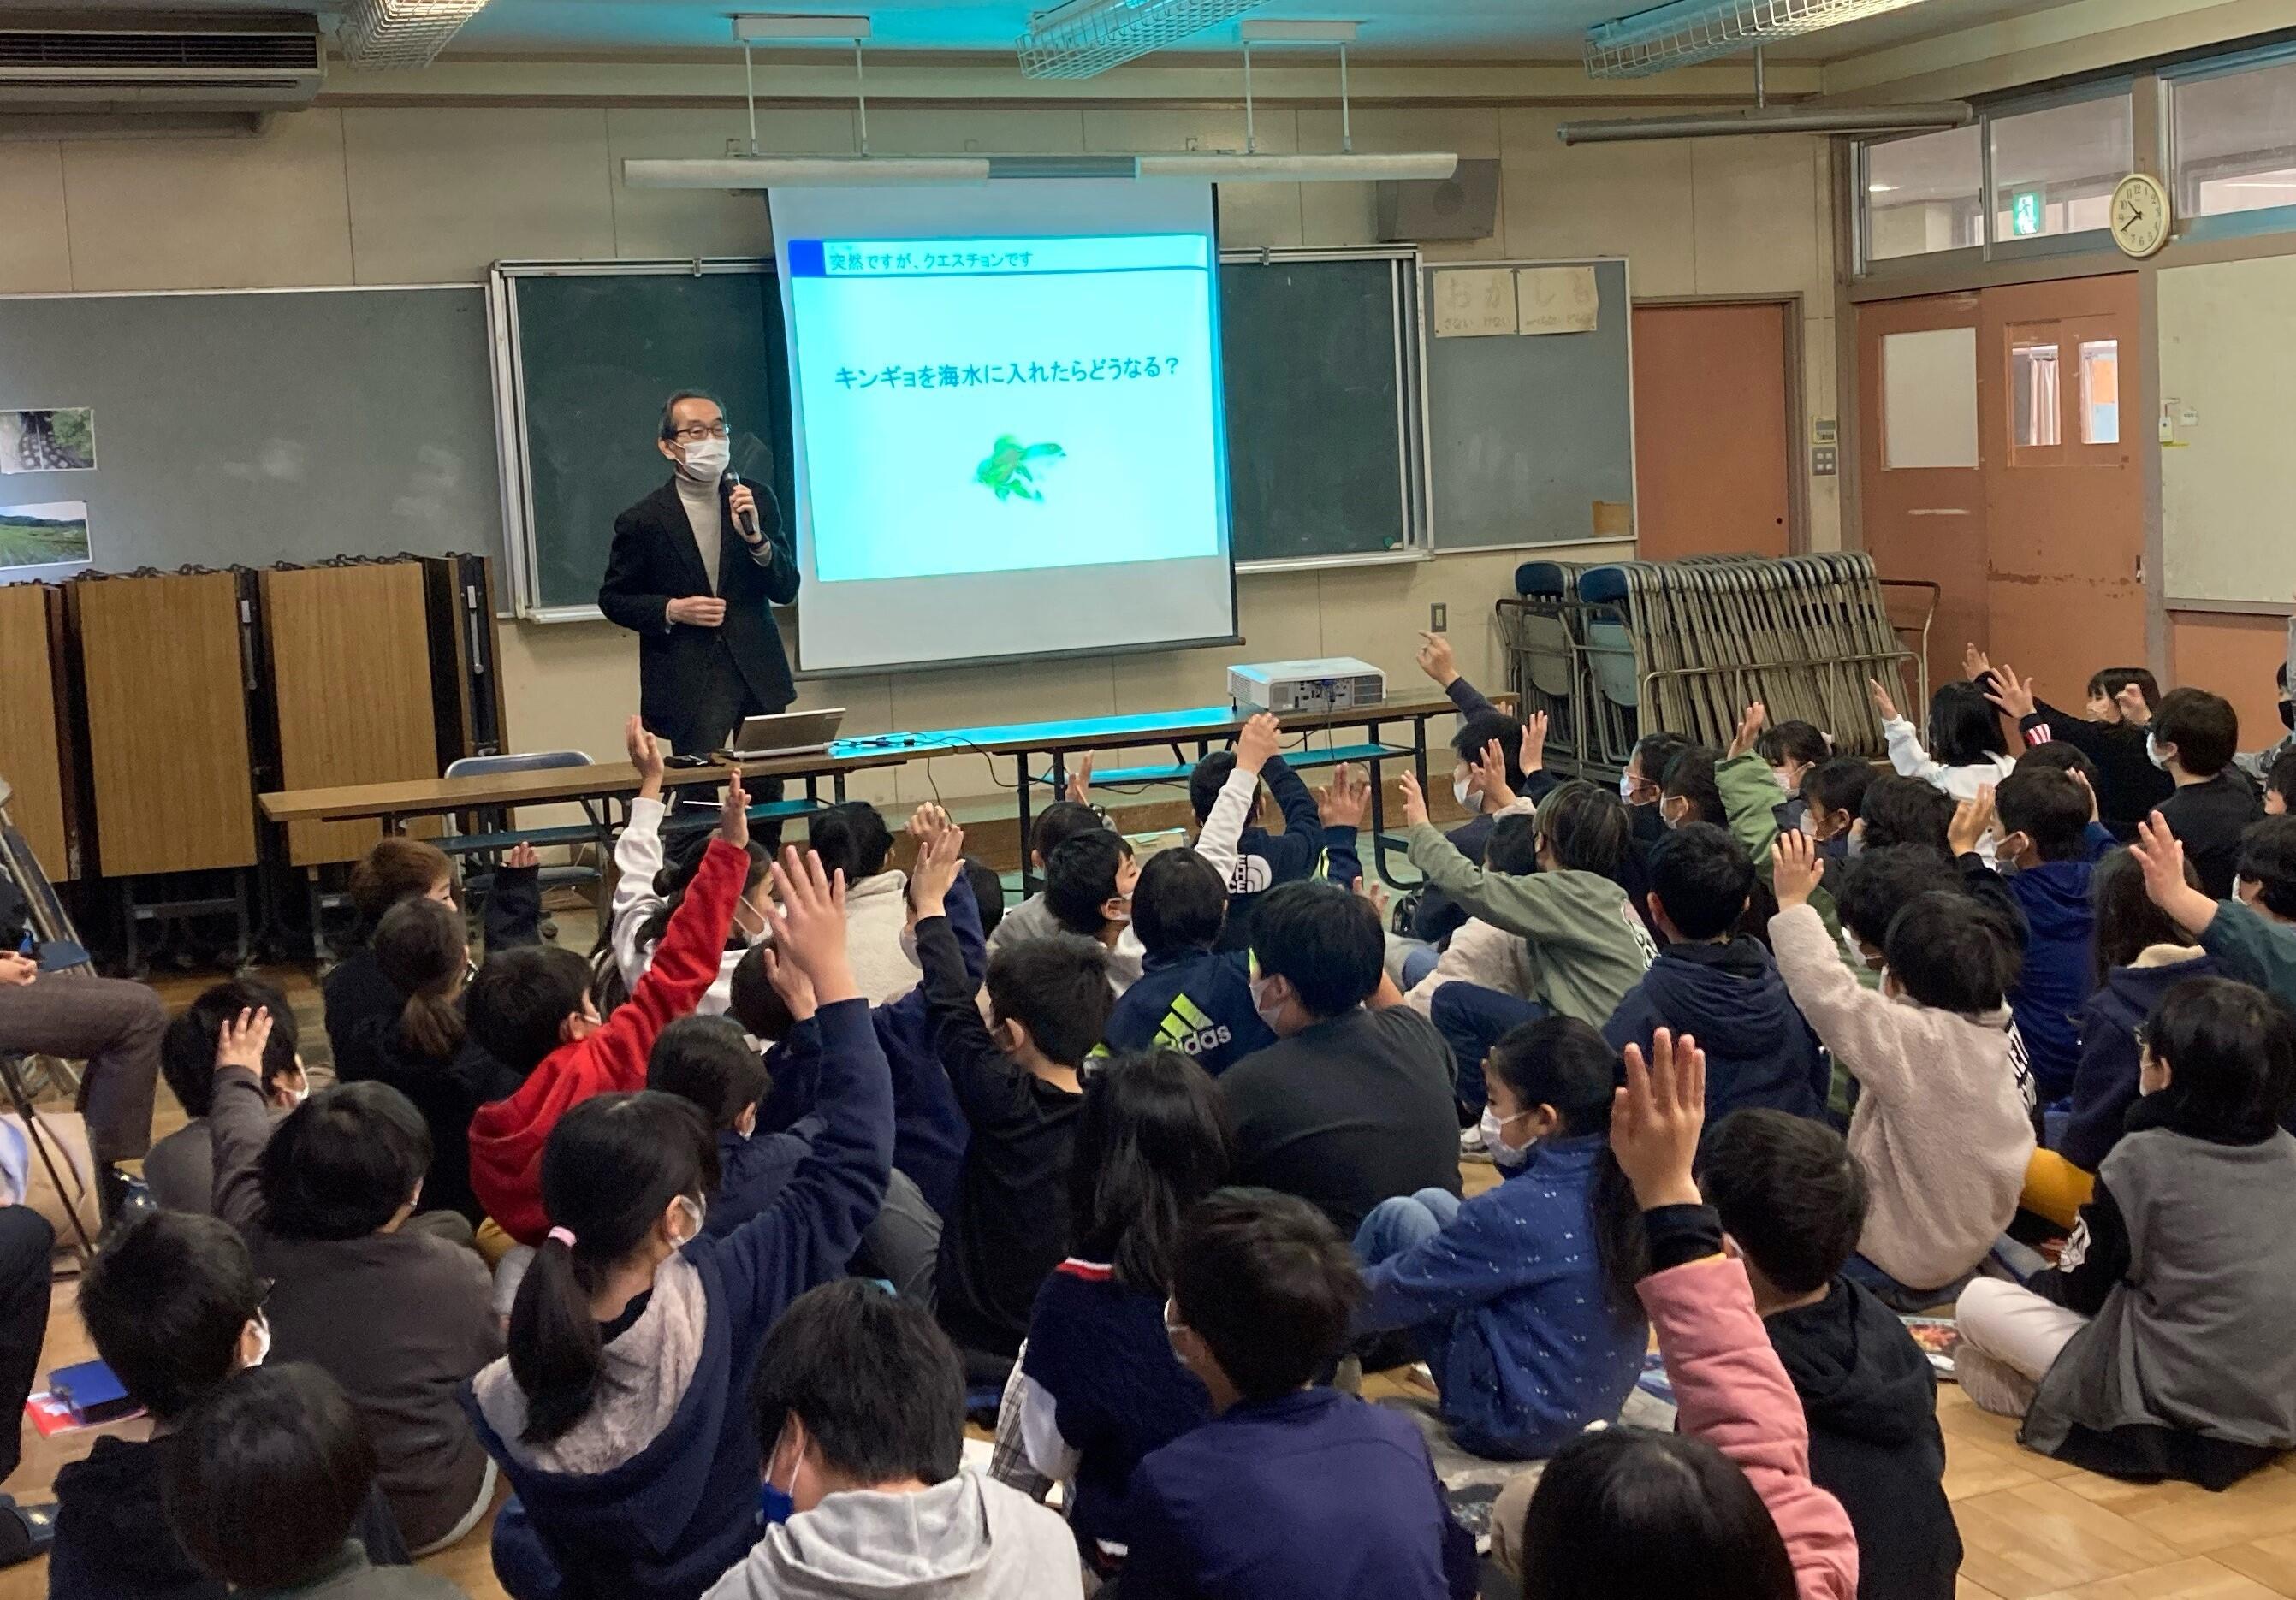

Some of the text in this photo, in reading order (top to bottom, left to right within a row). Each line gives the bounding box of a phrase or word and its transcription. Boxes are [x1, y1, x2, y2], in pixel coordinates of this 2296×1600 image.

[830, 252, 1033, 271] 突然ですが、クエスチョンです
[834, 356, 1179, 389] キンギョを海水に入れたらどうなる？
